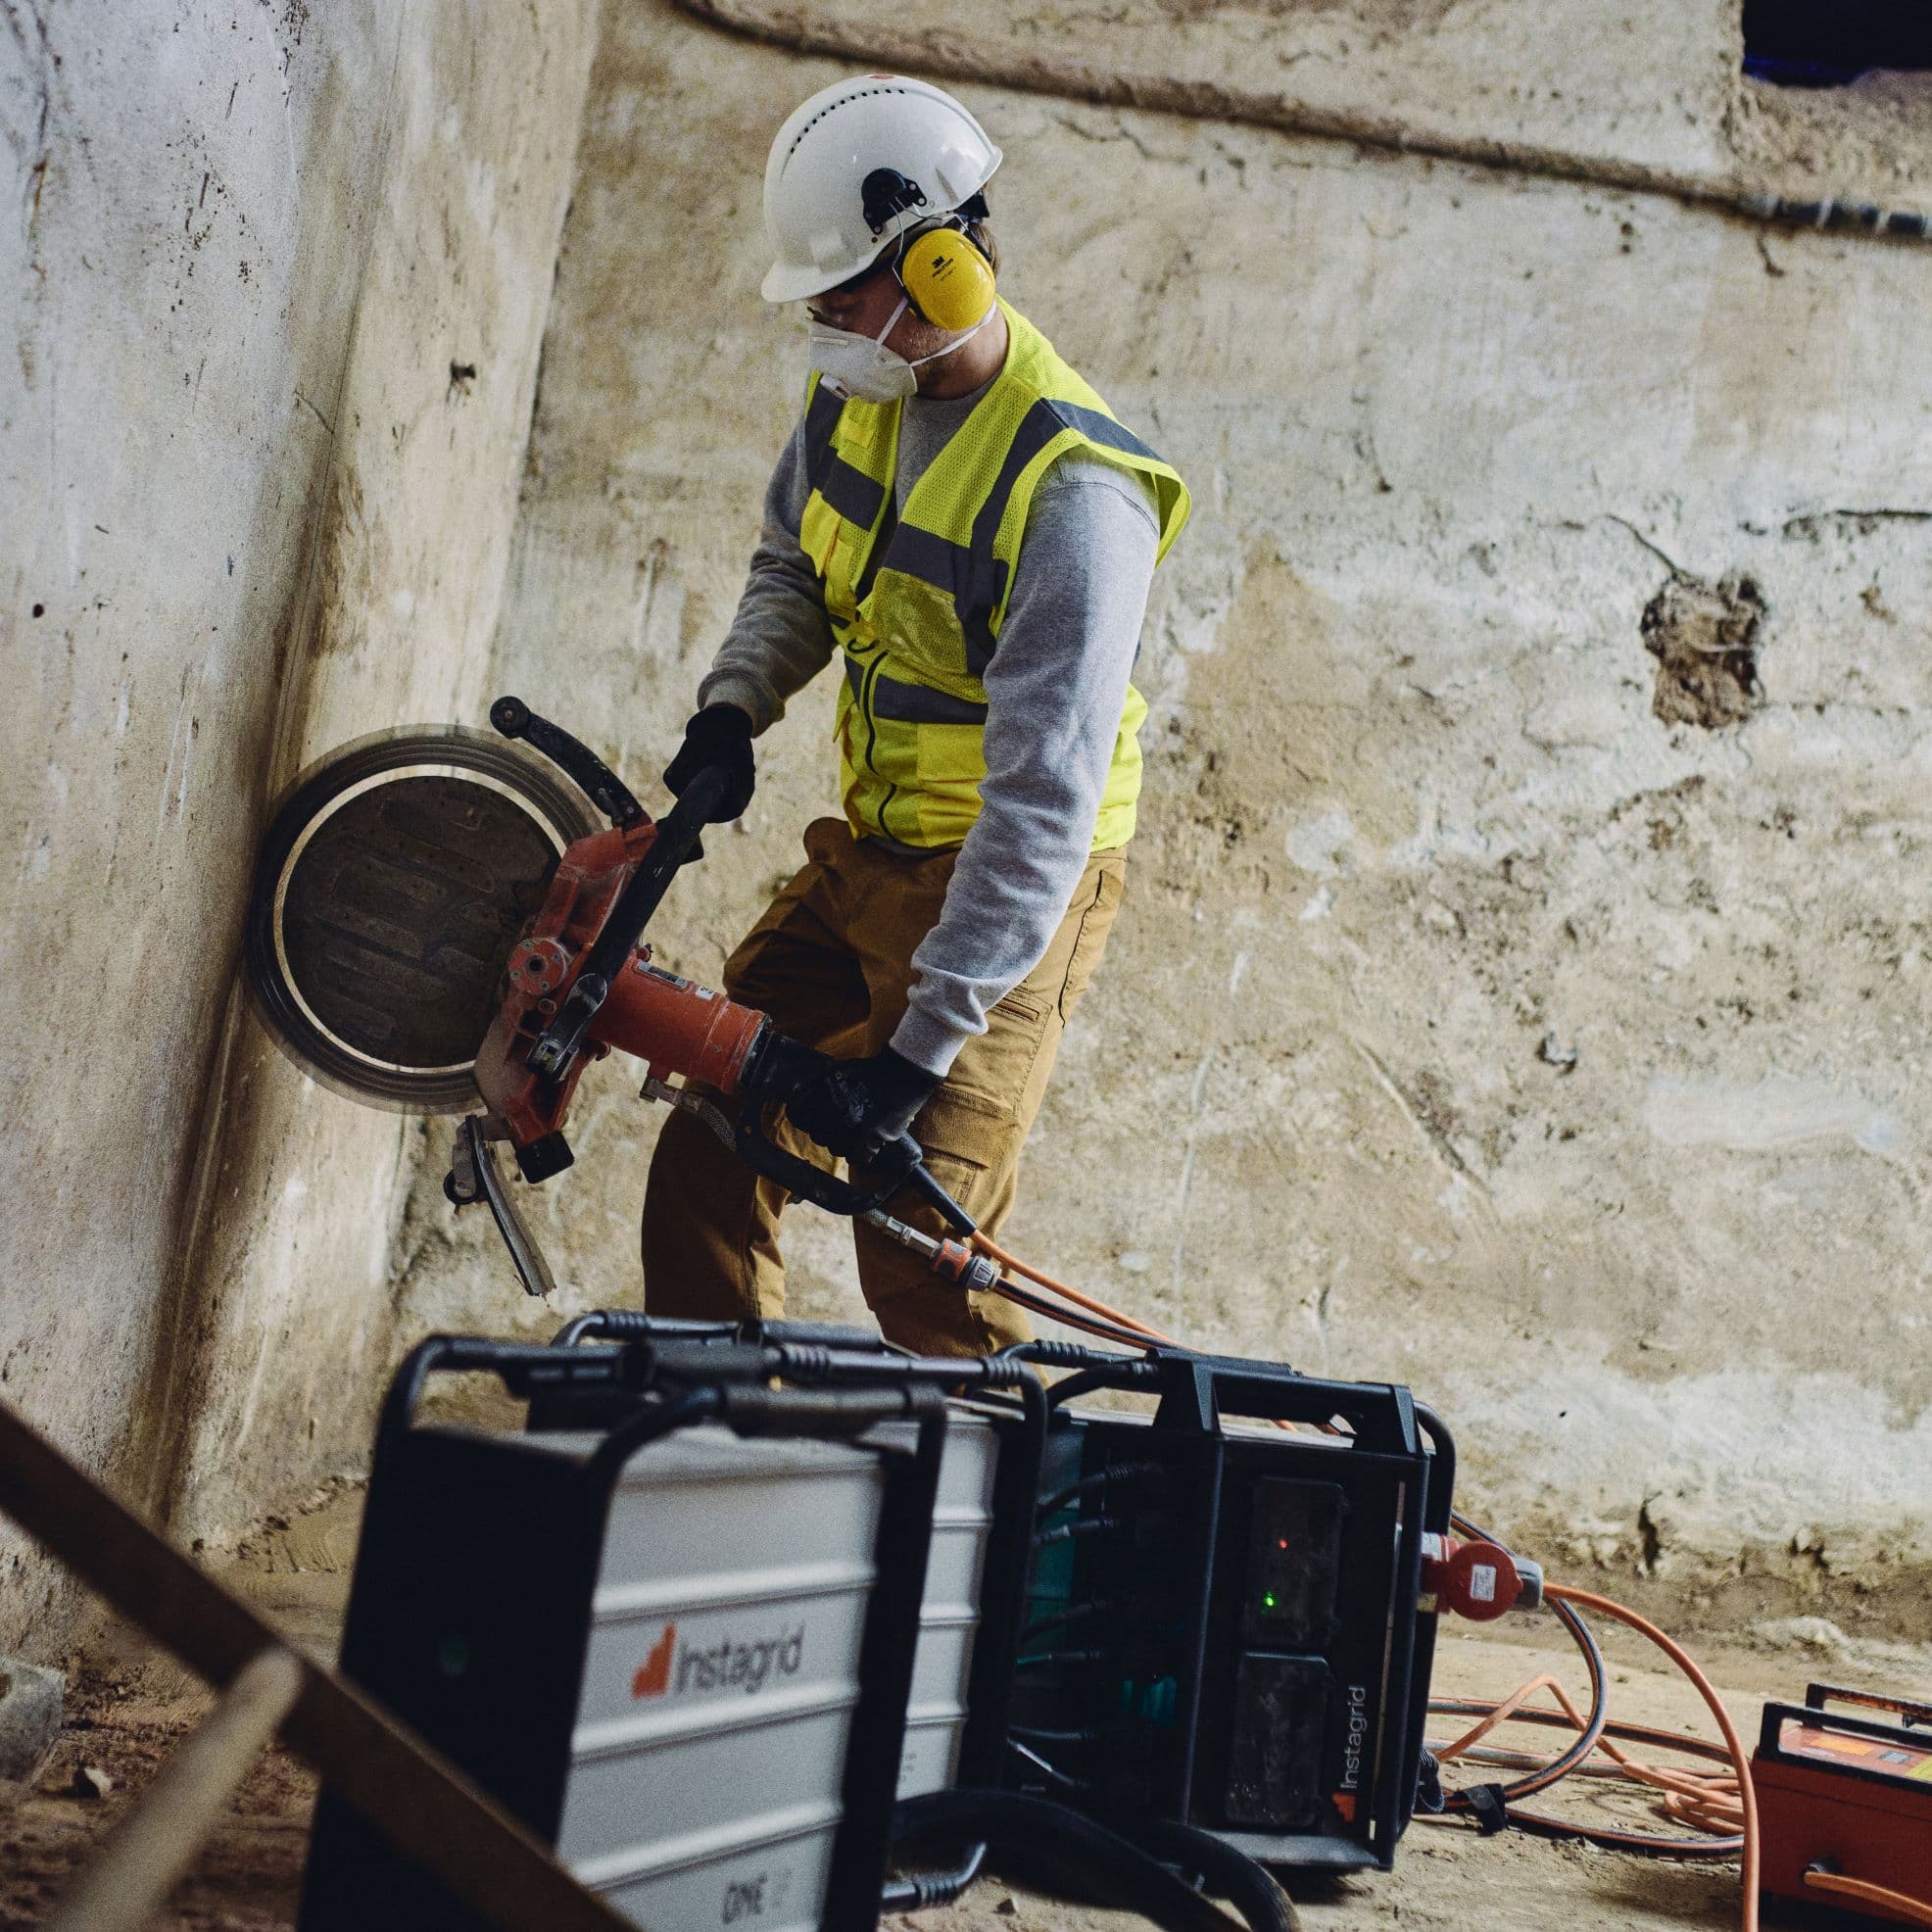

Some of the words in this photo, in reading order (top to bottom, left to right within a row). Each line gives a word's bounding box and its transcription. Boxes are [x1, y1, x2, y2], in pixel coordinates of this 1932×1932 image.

[932, 256, 945, 268] 3M
[676, 1622, 804, 1695] Instagrid
[1339, 1685, 1368, 1789] Instagrid
